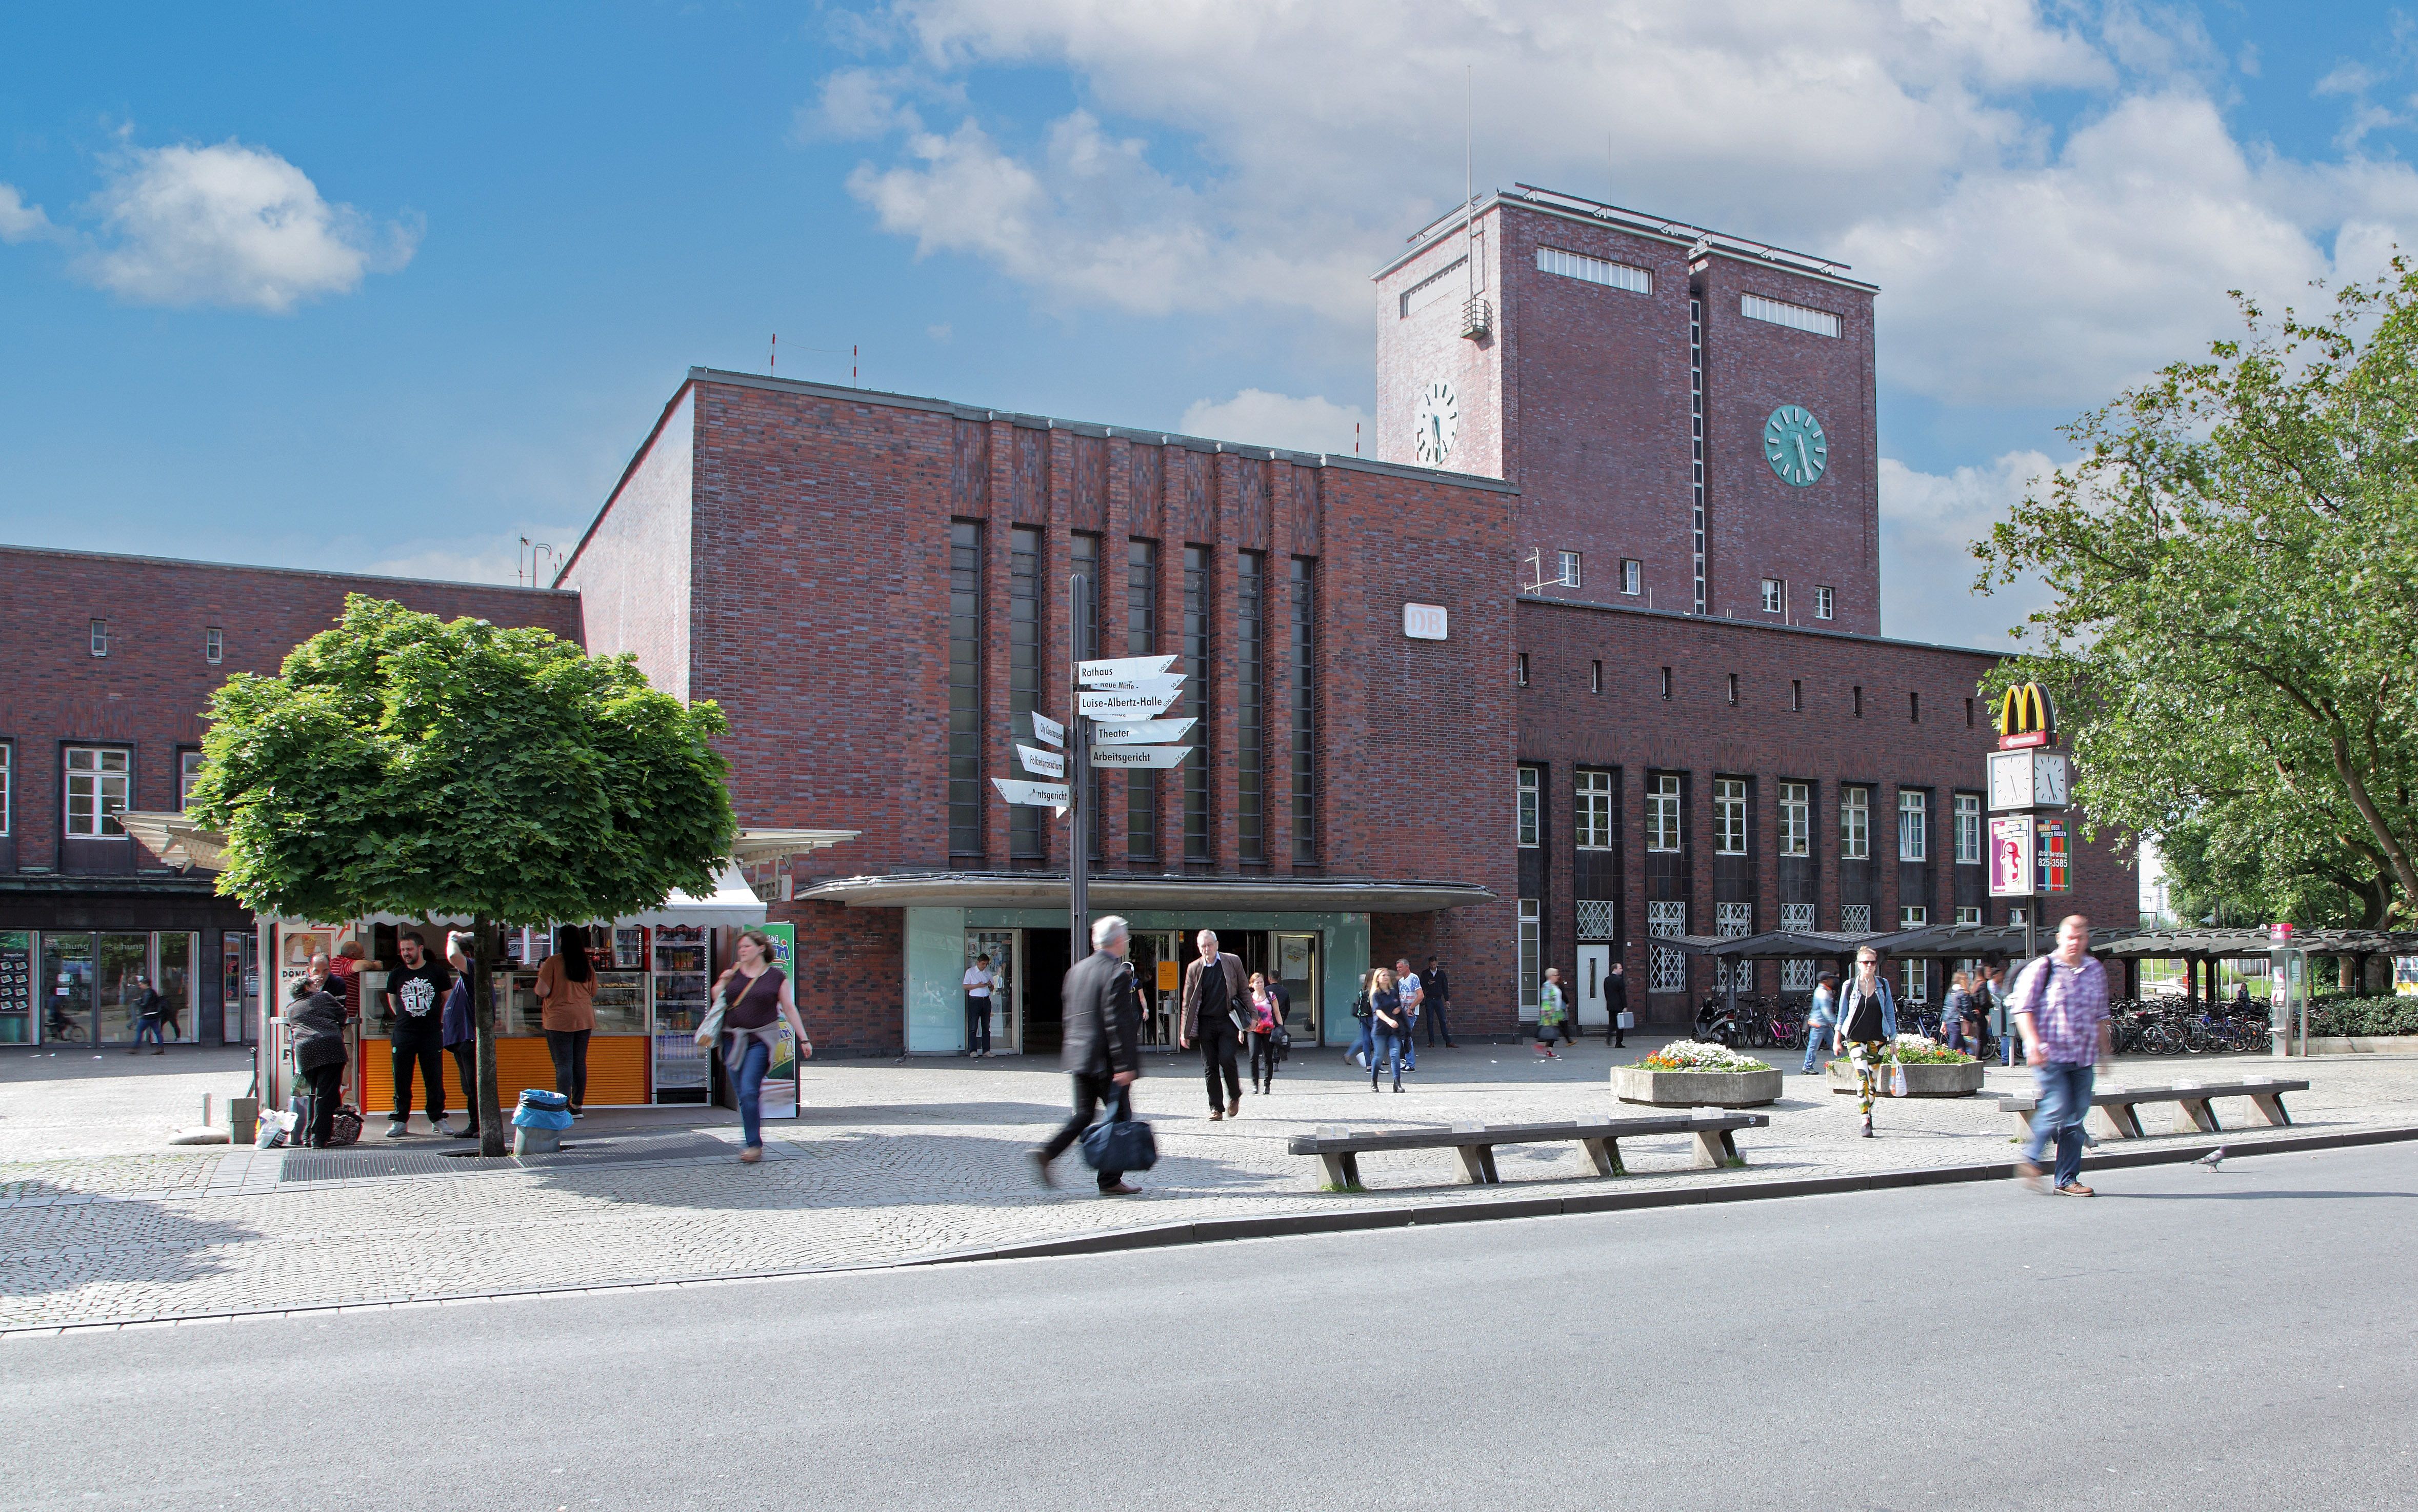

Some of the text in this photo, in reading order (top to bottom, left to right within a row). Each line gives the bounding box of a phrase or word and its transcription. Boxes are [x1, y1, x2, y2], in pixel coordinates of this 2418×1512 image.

[1411, 610, 1441, 633] DB
[1082, 667, 1113, 677] Rathaus
[1158, 663, 1168, 674] 500
[1083, 696, 1162, 708] Luise-Albertz-Halle
[1163, 699, 1172, 708] 500
[1099, 729, 1130, 738] Theater
[1177, 725, 1187, 736] 700
[1093, 752, 1150, 763] Arbeitsgericht
[2038, 858, 2068, 868] 825-3585
[283, 968, 307, 978] DÖNE
